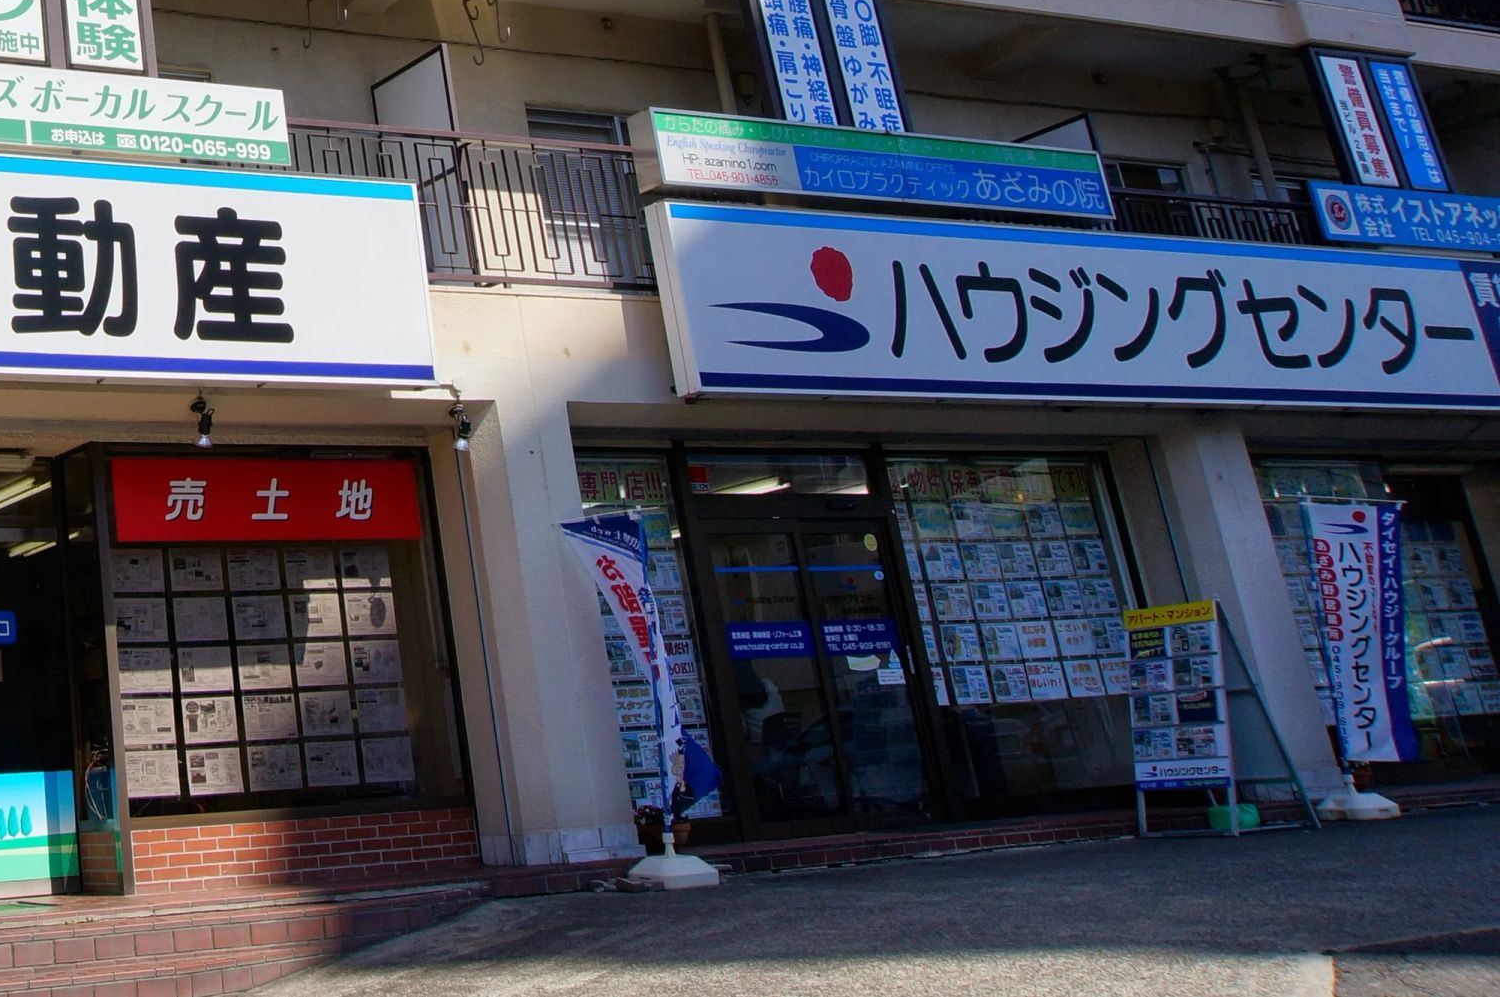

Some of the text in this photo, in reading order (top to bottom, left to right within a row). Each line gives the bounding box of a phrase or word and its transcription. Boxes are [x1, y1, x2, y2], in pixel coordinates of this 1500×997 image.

[50, 128, 271, 161] お申込は 0120-065-999
[667, 135, 697, 151] English
[700, 139, 736, 154] Speaking
[804, 166, 1105, 210] カイロプラクティック あざみの院
[1391, 196, 1500, 229] イストアネッ
[891, 260, 1474, 374] ハウジングセンター
[1127, 606, 1210, 624] アパート・マンション
[1338, 541, 1376, 751] ハウジングセンター
